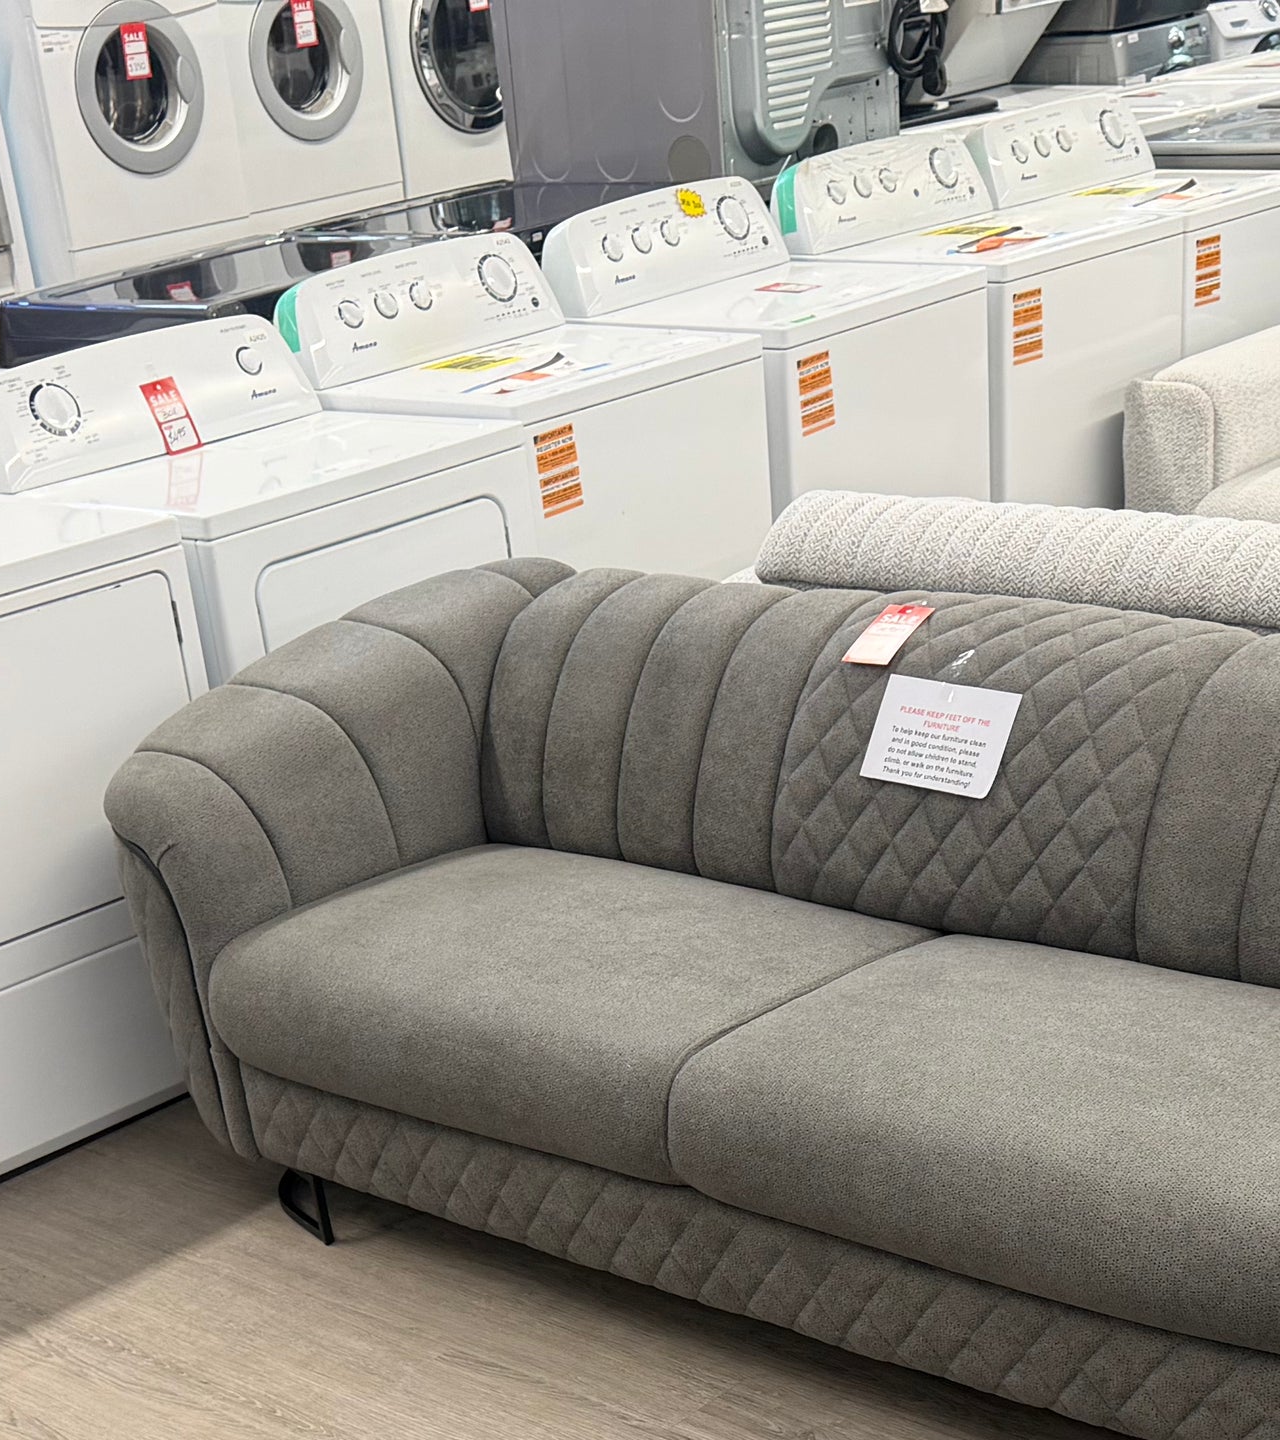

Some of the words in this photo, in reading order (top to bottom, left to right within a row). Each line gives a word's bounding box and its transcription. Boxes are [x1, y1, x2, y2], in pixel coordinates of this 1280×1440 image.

[123, 32, 143, 42] SALE
[614, 274, 636, 285] Amana
[352, 340, 377, 352] Amana
[150, 390, 178, 406] SALE
[251, 388, 277, 400] Amana
[880, 614, 920, 624] SALE
[900, 706, 925, 716] PLEASE
[926, 711, 945, 719] KEEP
[945, 713, 961, 721] FEET
[961, 716, 976, 724] OFF
[978, 719, 991, 727] THE
[923, 720, 961, 732] FURNITURE
[900, 726, 913, 735] help
[914, 730, 929, 738] keep
[942, 734, 968, 745] furniture
[969, 739, 986, 748] clean
[907, 750, 923, 758] allow
[924, 753, 949, 761] children
[958, 748, 980, 758] please
[882, 766, 900, 774] Thank
[901, 769, 912, 777] you
[913, 771, 923, 779] for
[910, 761, 925, 770] walk
[935, 764, 945, 773] the
